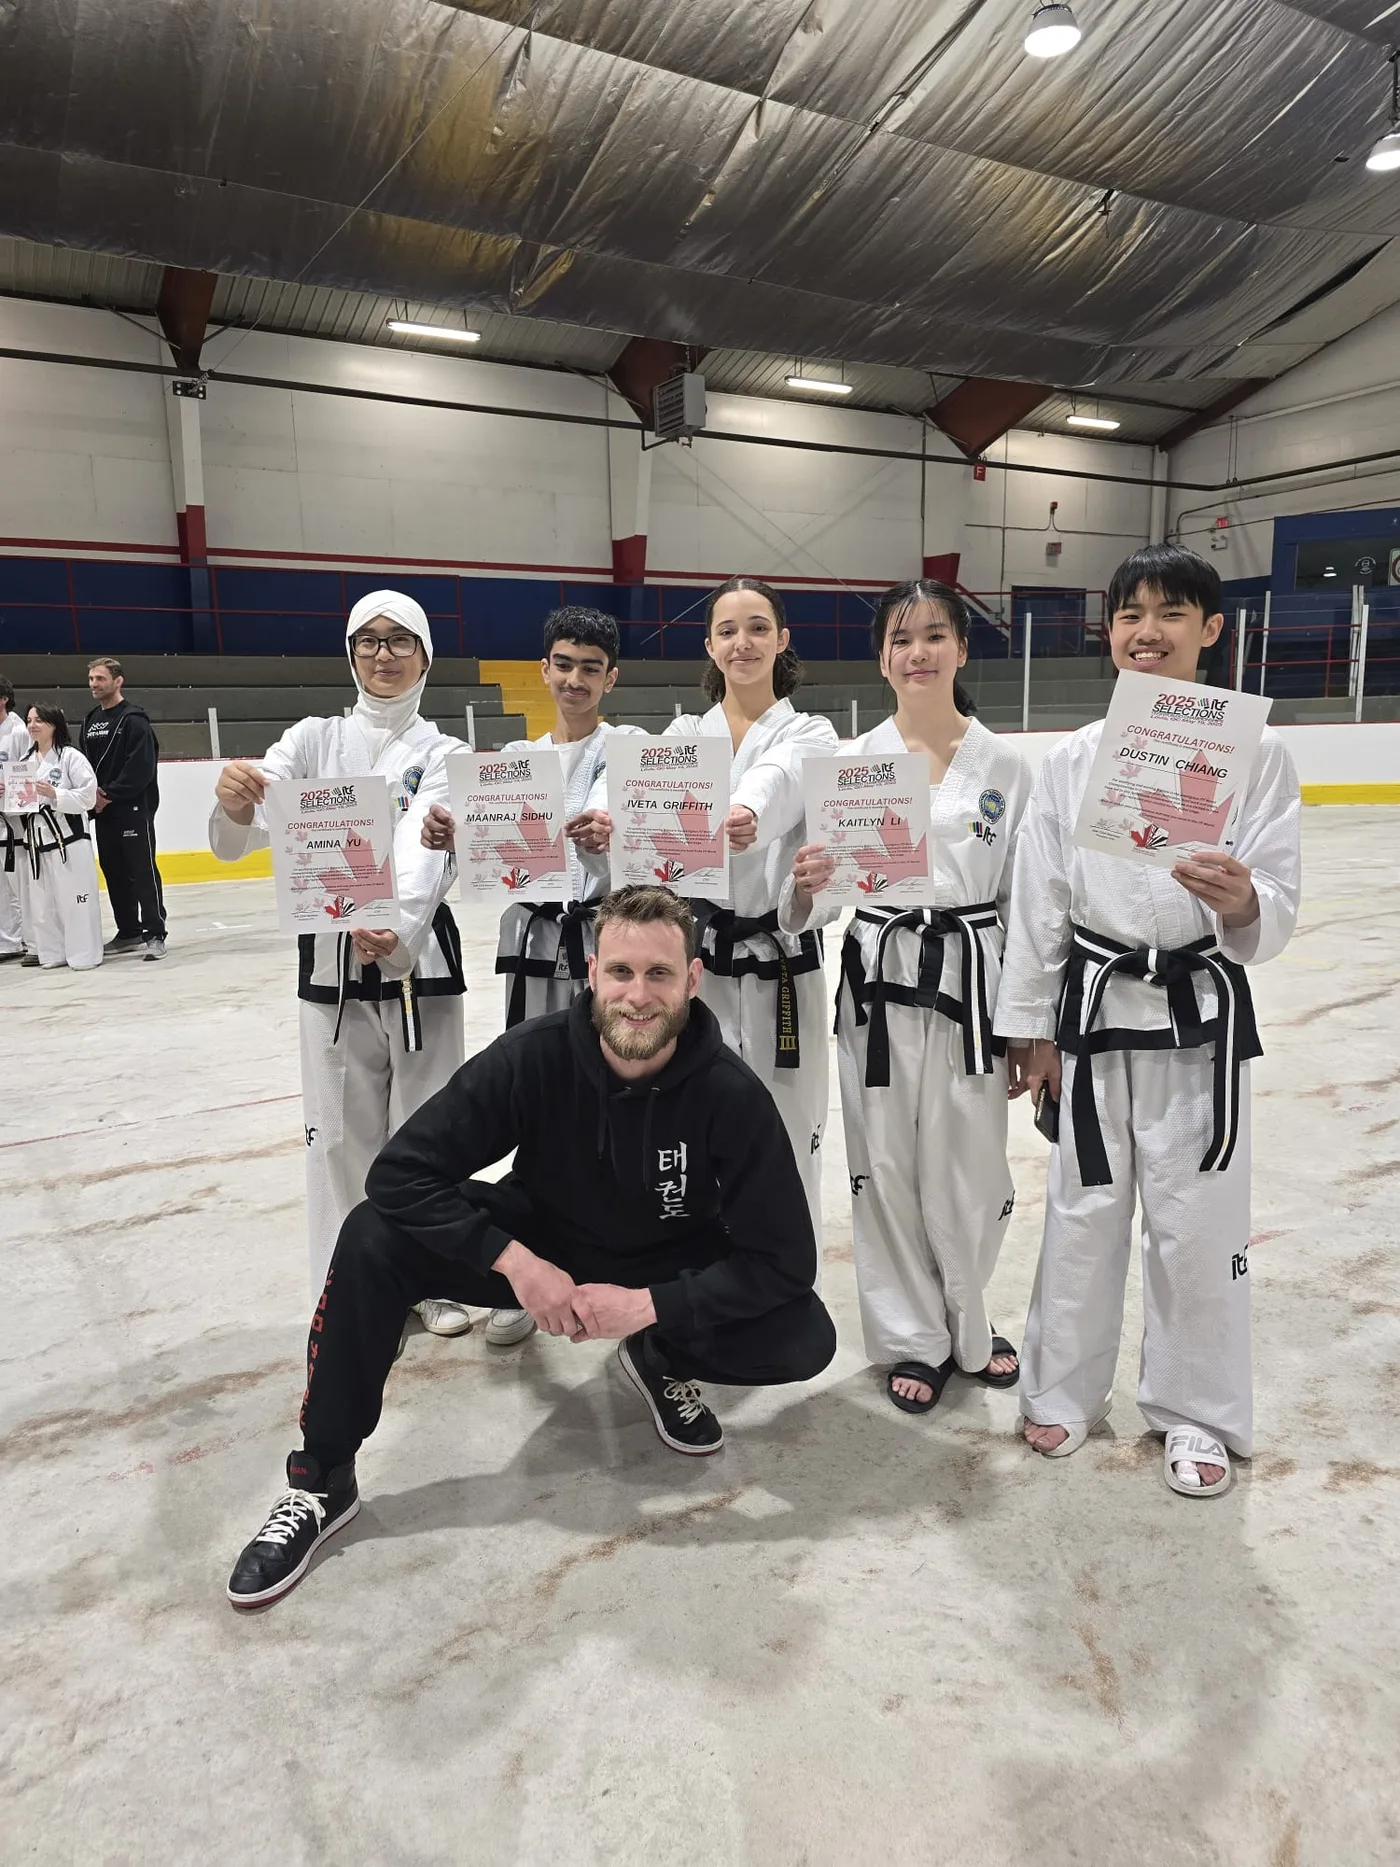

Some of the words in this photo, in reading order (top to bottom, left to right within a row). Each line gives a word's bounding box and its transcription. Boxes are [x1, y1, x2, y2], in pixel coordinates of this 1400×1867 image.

[1156, 693, 1196, 708] 2025
[1211, 699, 1229, 710] itf
[1152, 704, 1225, 720] SELECTIONS
[1127, 724, 1235, 754] CONGRATULATIONS!
[641, 747, 672, 758] 2025
[684, 745, 697, 755] itf
[479, 763, 507, 774] 2025
[518, 759, 529, 769] itf
[640, 755, 698, 766] SELECTIONS
[1119, 747, 1170, 766] DUSTIN
[1175, 759, 1228, 778] CHIANG
[479, 769, 531, 781] SELECTIONS
[837, 772, 895, 786] SELECTIONS
[838, 766, 869, 779] 2025
[625, 779, 713, 790] CONGRATULATIONS!
[300, 789, 330, 801] 2025
[342, 785, 354, 796] itf
[467, 793, 548, 802] CONGRATULATIONS!
[300, 795, 356, 809] SELECTIONS
[627, 799, 657, 809] IVETA
[663, 801, 713, 811] GRIFFITH
[823, 796, 912, 808] CONGRATULATIONS!
[466, 813, 516, 822] MAANRAJ
[521, 812, 553, 821] SIDHU
[838, 817, 885, 828] KAITLYN
[890, 817, 901, 826] LI
[287, 819, 374, 830] CONGRATULATIONS!
[306, 839, 341, 849] AMINA
[347, 838, 361, 847] YU
[781, 986, 792, 1034] GRIFFITH
[654, 1141, 691, 1219] 태권도
[1170, 1435, 1225, 1457] FILA
